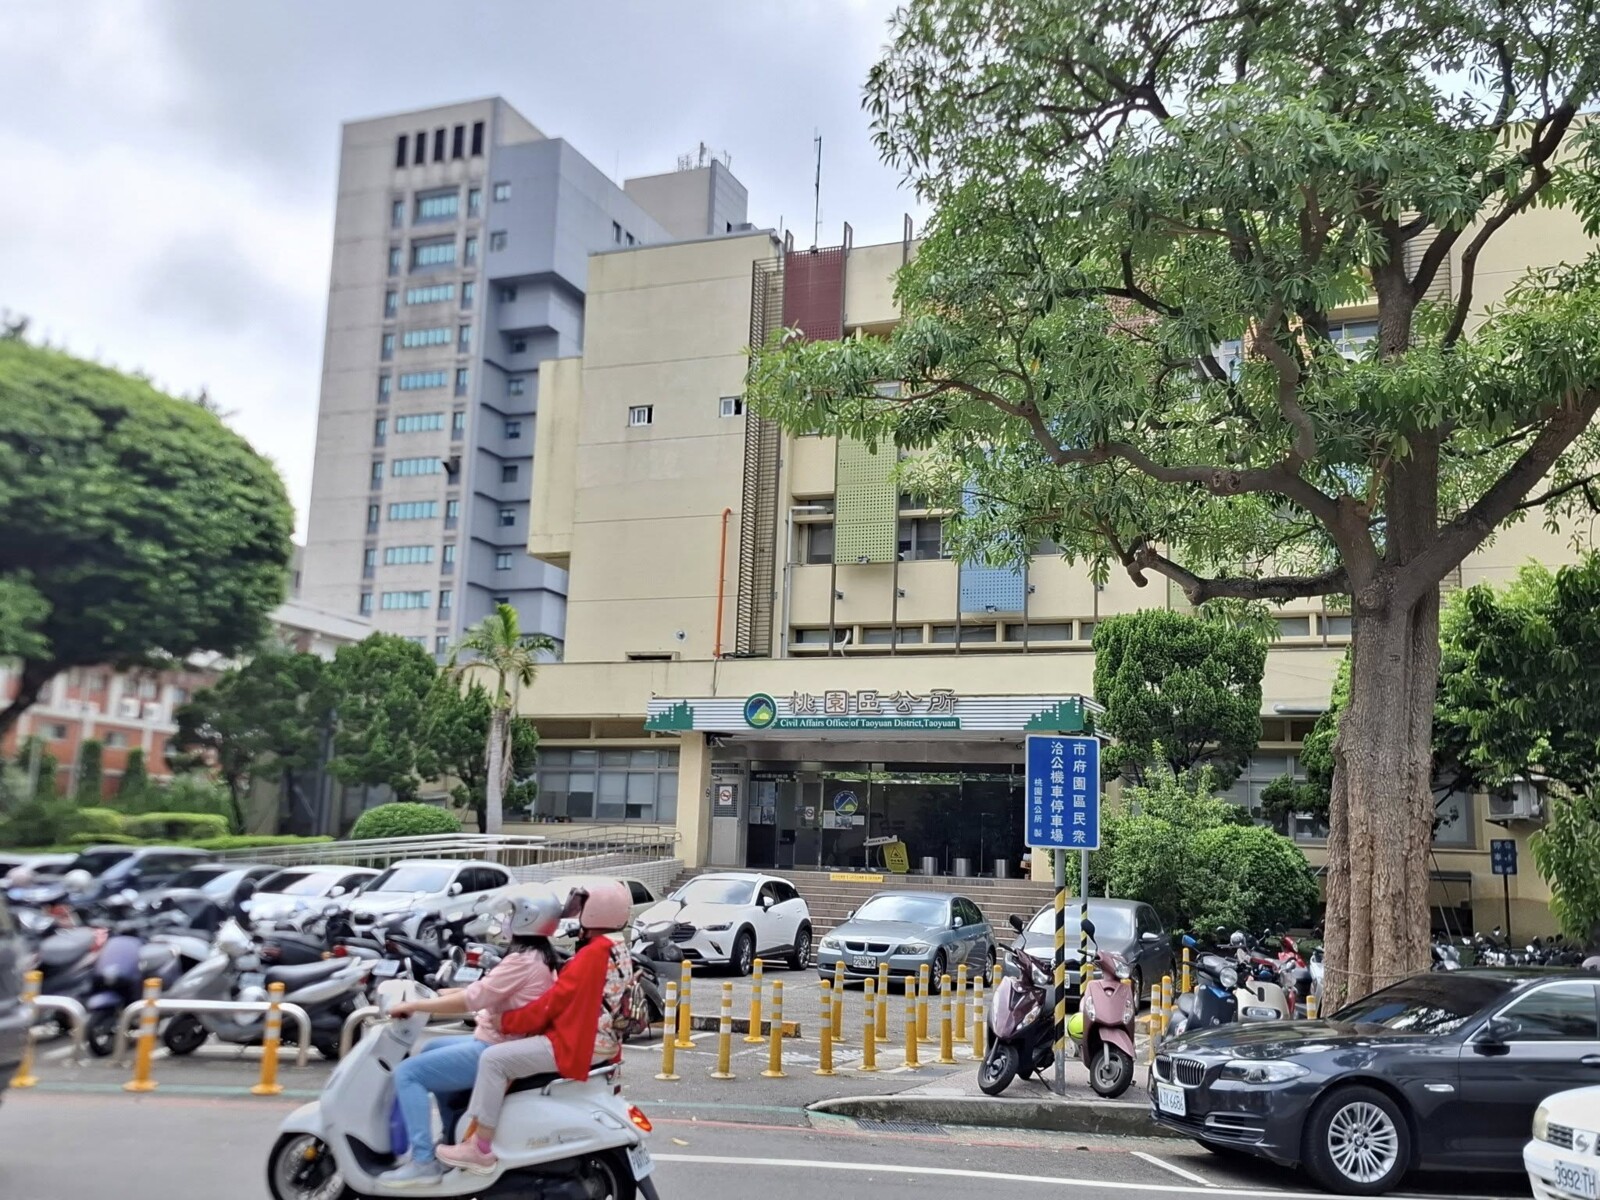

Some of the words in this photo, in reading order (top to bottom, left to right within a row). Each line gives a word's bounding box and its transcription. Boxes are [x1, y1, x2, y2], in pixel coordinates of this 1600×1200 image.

[788, 688, 959, 715] 桃園區公所
[780, 718, 798, 728] Civil
[799, 718, 825, 728] Affairs
[825, 718, 849, 728] Office
[850, 718, 860, 728] of
[861, 718, 892, 729] Taoyuan
[1050, 741, 1065, 843] 洽公機車停車場
